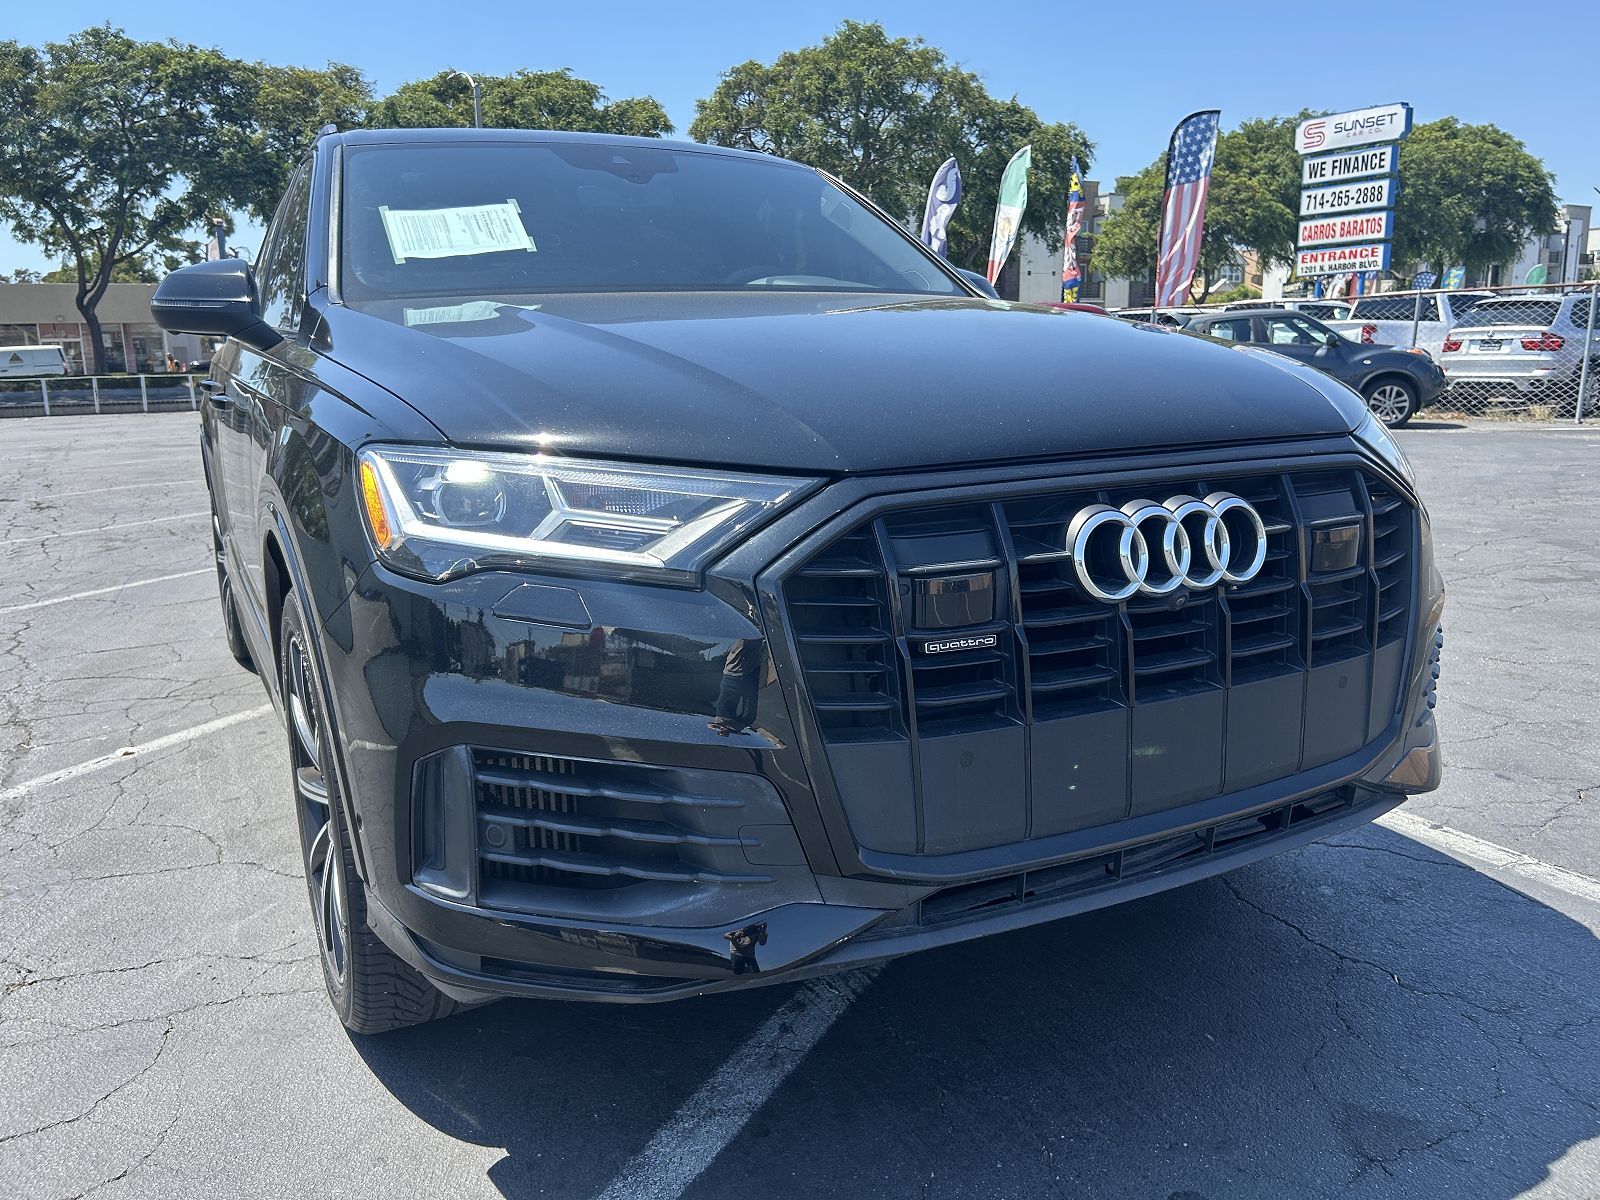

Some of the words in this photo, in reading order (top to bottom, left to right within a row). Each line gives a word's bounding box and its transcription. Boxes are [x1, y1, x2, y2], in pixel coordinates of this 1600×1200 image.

[1334, 112, 1398, 134] SUNSET
[1308, 161, 1327, 179] WE
[1331, 152, 1386, 176] FINANCE
[1306, 185, 1383, 211] 714-265-2888
[1302, 222, 1337, 242] CARROS
[1340, 217, 1382, 238] BARATOS
[1301, 247, 1379, 264] ENTRANCE
[1300, 265, 1316, 274] 1201
[1328, 262, 1357, 271] HARBOR
[1359, 260, 1380, 269] BLVD.
[930, 637, 994, 652] quattro
